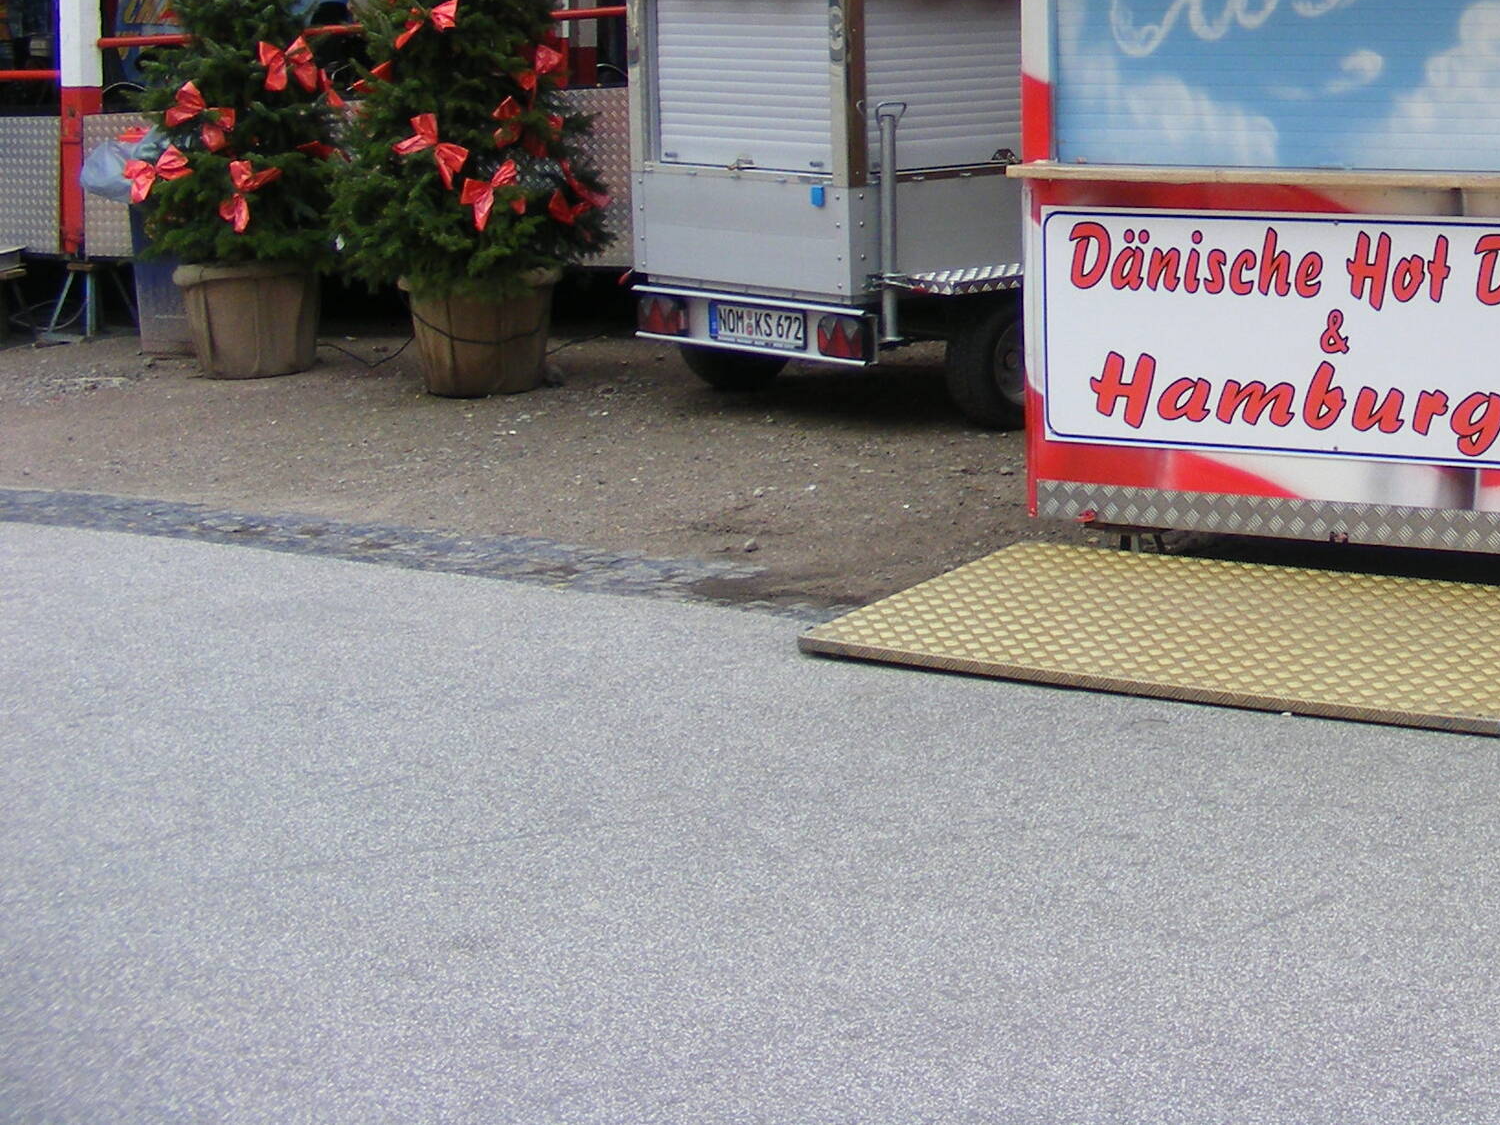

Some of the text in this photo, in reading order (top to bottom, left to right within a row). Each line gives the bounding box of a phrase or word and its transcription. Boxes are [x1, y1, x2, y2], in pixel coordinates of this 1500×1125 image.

[1067, 219, 1325, 302] Dänische
[1344, 230, 1451, 313] Hot
[719, 307, 803, 342] NOM KS 672
[1318, 308, 1351, 355] &
